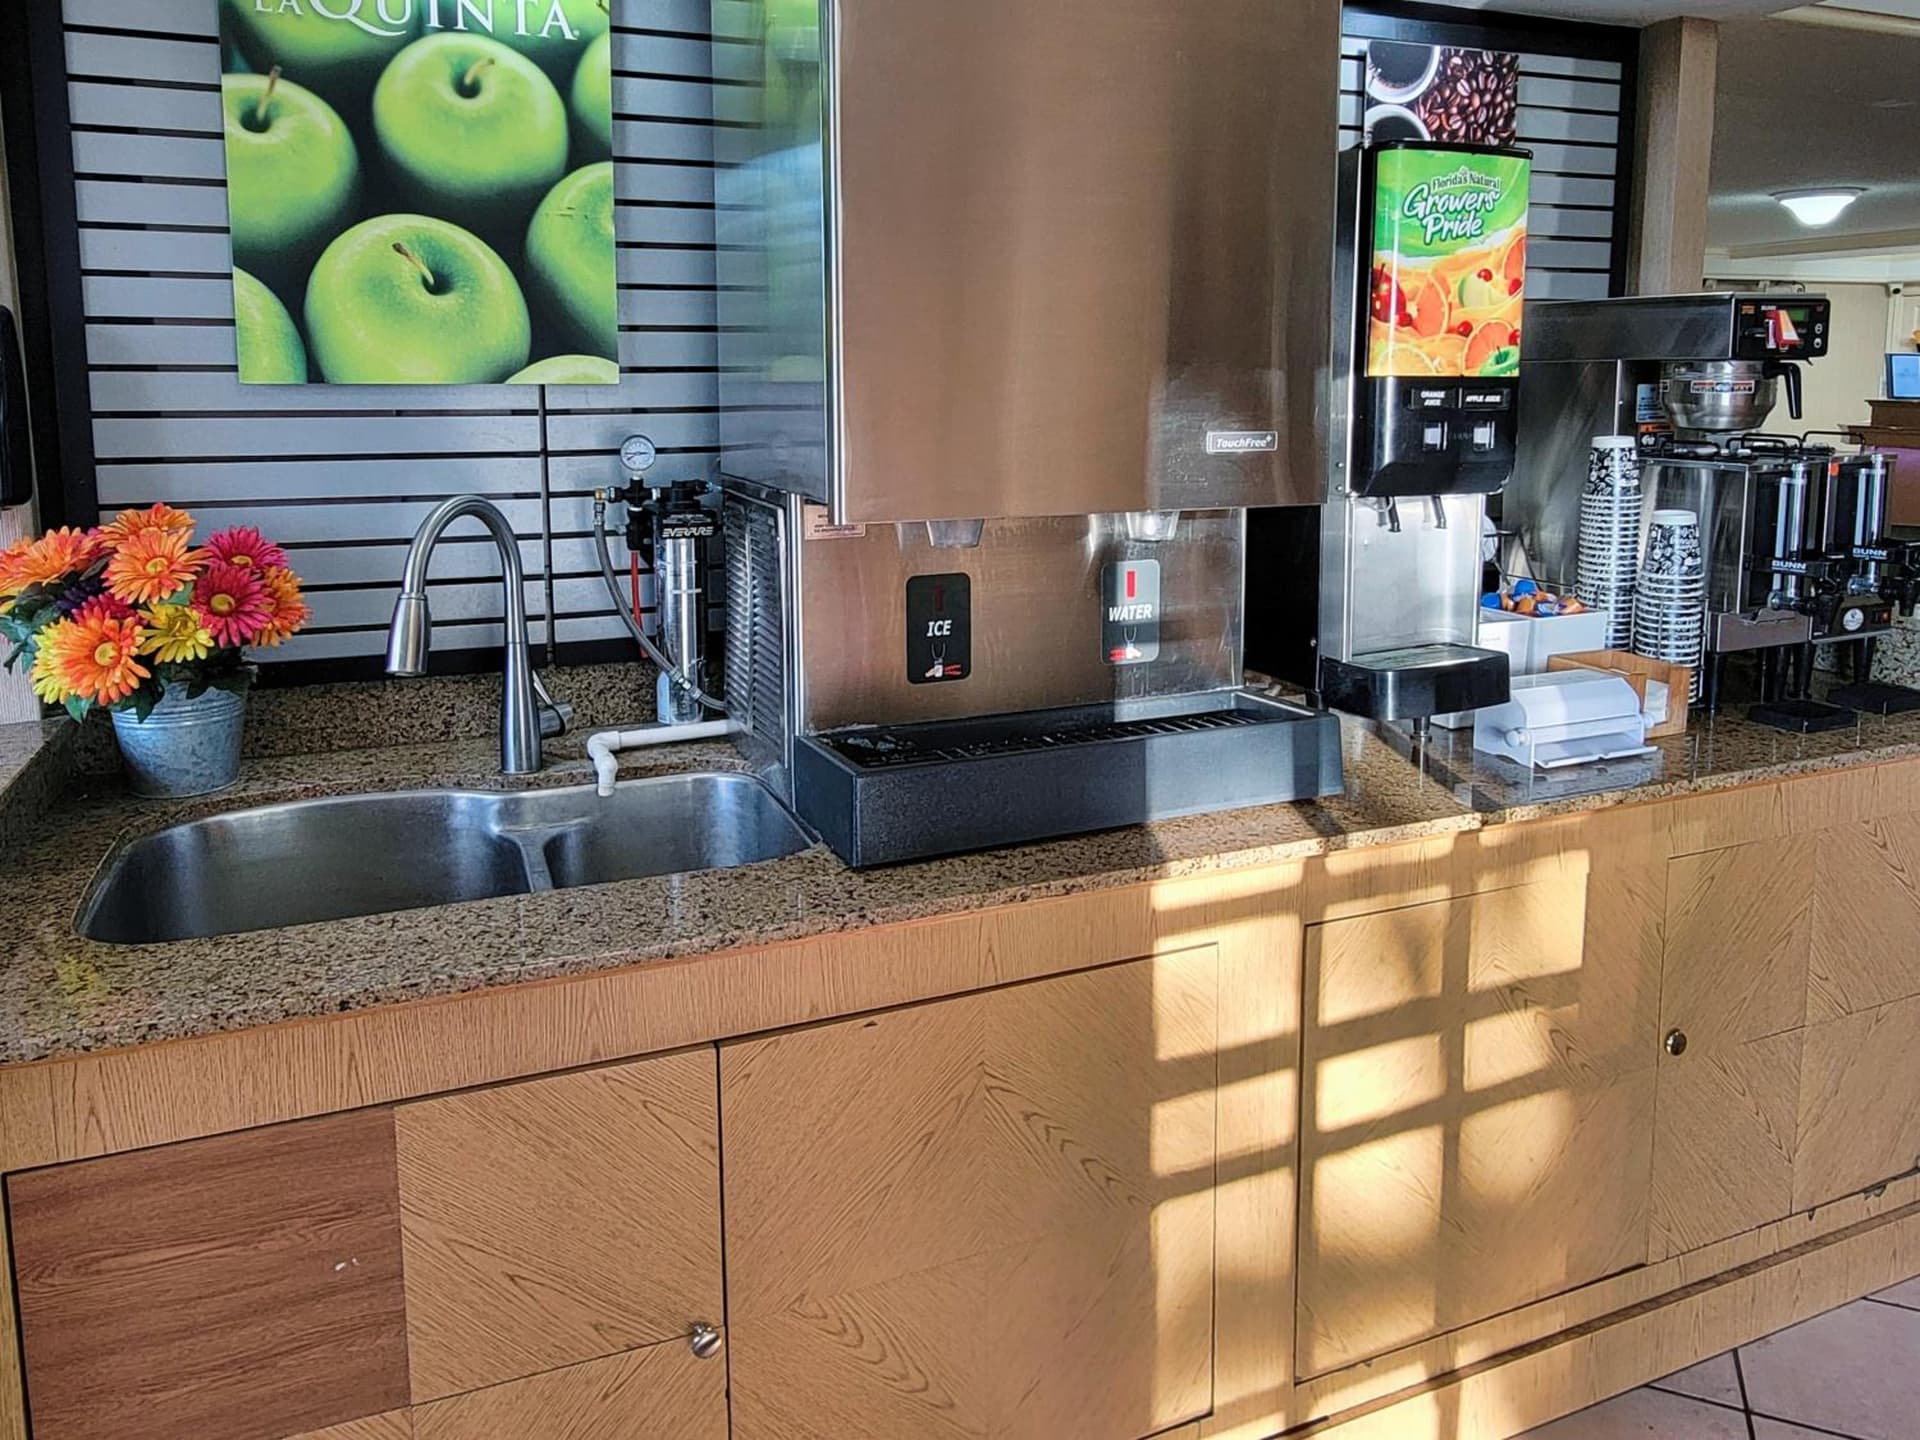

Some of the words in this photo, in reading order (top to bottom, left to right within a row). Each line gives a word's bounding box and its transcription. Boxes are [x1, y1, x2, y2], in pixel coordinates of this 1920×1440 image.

[1469, 173, 1500, 189] Natural
[1423, 211, 1482, 243] Pride
[662, 526, 713, 537] EVERPURE
[1852, 548, 1887, 556] BUNN
[1771, 560, 1806, 569] BUNN
[1109, 604, 1152, 622] WATER
[927, 620, 952, 637] ICE
